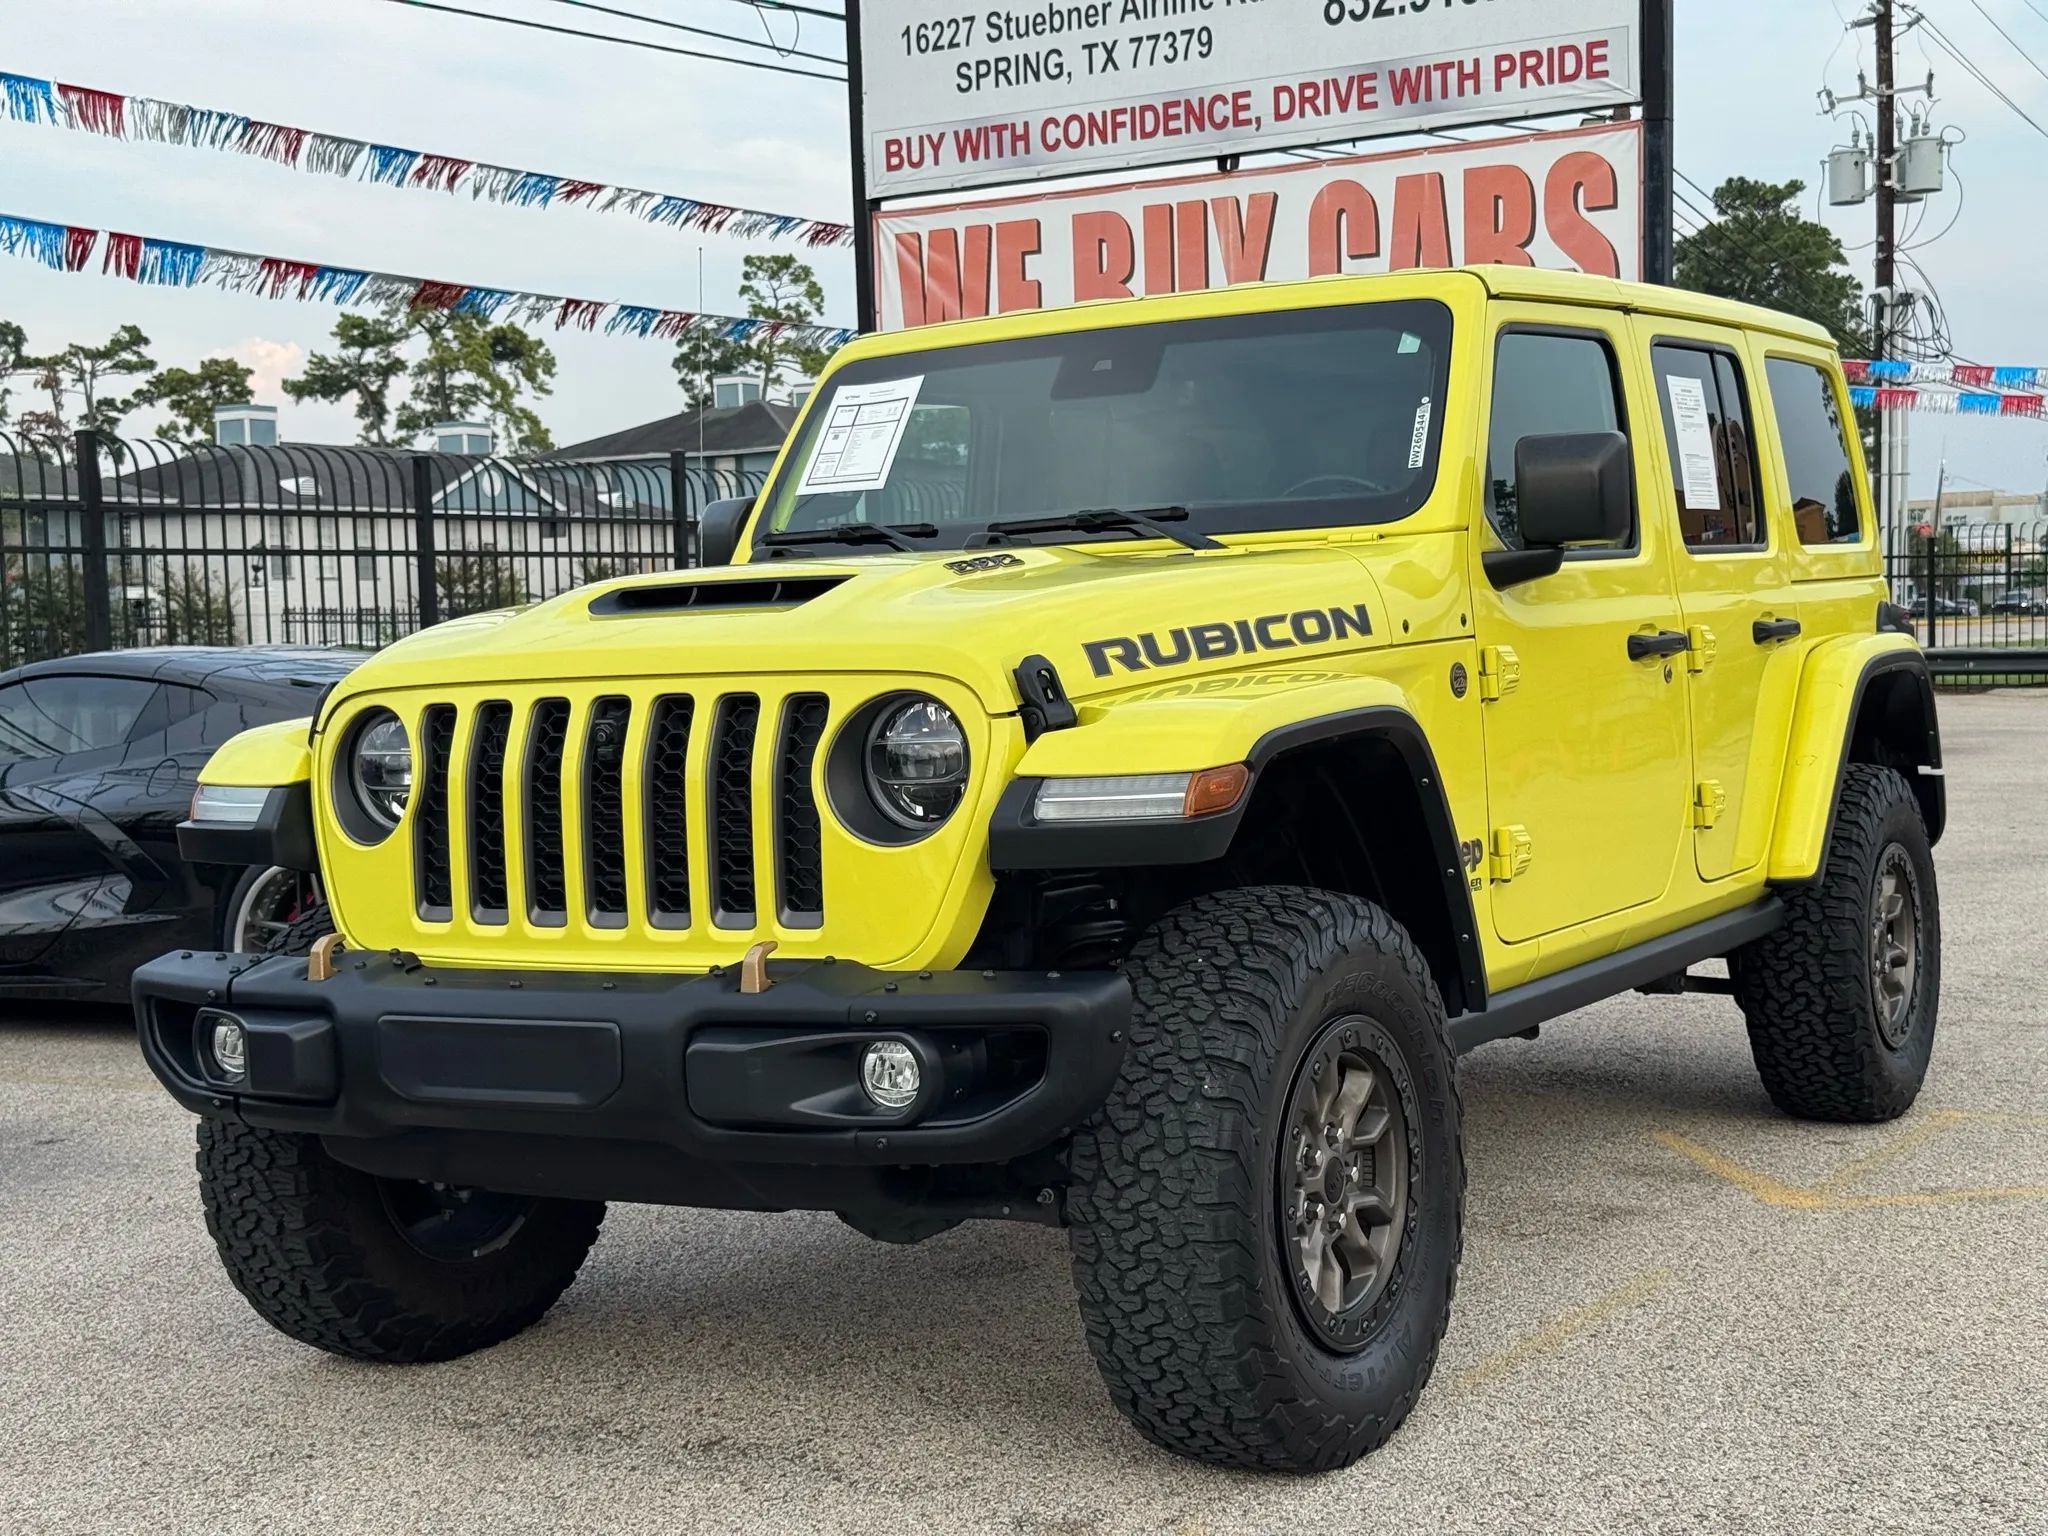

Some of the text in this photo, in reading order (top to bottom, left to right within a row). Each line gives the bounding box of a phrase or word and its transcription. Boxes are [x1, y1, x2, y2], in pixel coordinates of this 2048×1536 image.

[901, 15, 976, 56] 16227
[986, 1, 1112, 43] Stuebner
[956, 25, 1213, 93] SPRING, TX 77379
[885, 39, 1609, 172] BUY WITH CONFIDENCE, DRIVE WITH PRIDE
[895, 218, 1042, 329] WE
[1308, 151, 1621, 279] CARS
[1410, 413, 1426, 467] NW260544
[1081, 604, 1373, 678] RUBICON
